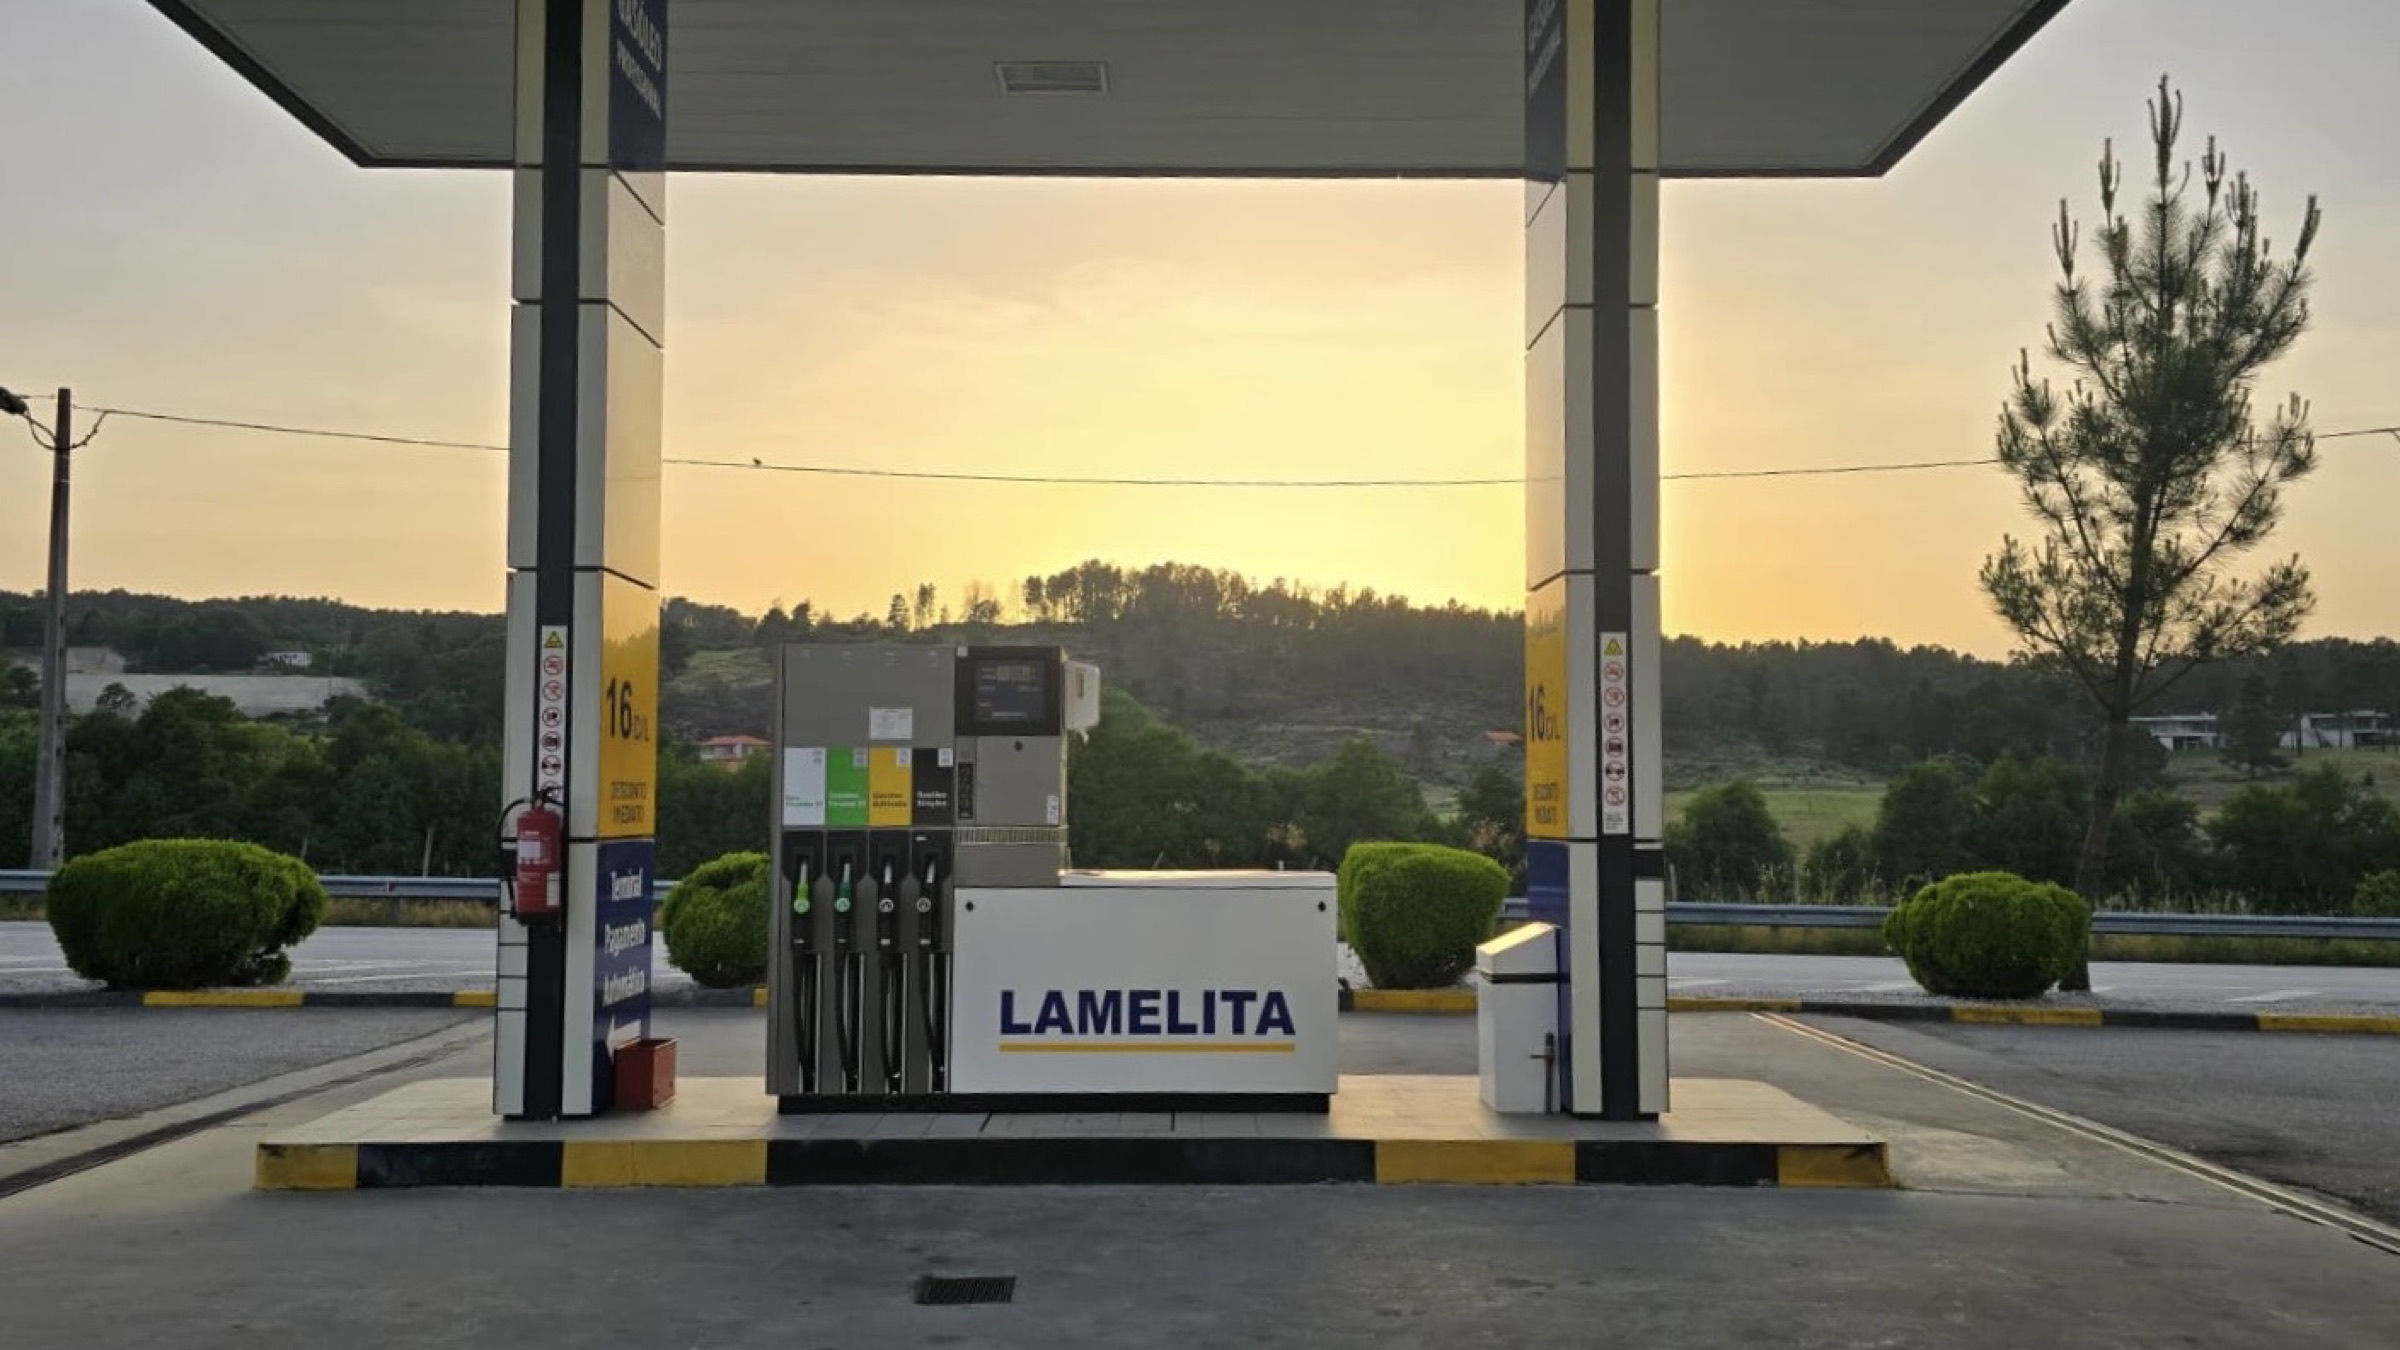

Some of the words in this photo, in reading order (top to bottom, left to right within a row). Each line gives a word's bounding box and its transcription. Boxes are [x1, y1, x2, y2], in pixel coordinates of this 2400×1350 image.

[606, 676, 633, 740] 16
[610, 867, 644, 902] Terminal
[604, 918, 646, 957] Pagamento
[1000, 989, 1296, 1035] LAMELITA
